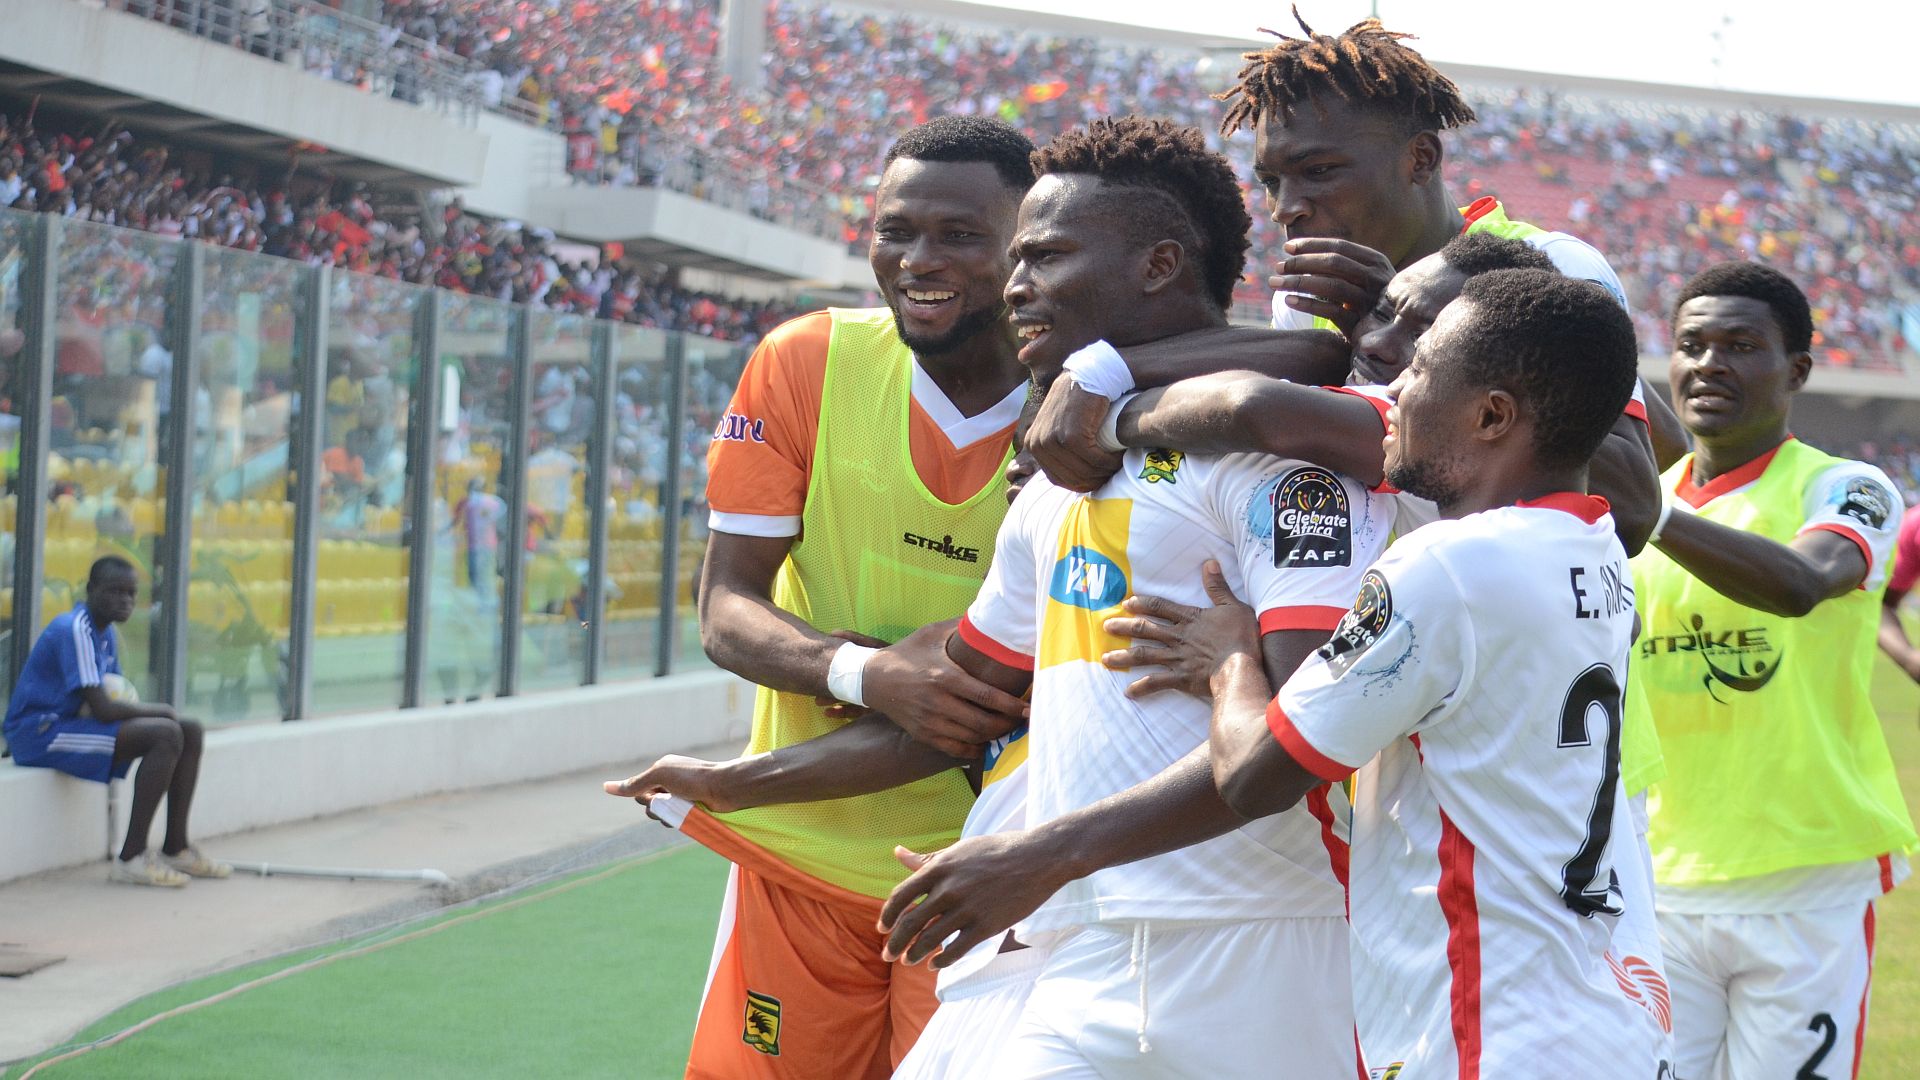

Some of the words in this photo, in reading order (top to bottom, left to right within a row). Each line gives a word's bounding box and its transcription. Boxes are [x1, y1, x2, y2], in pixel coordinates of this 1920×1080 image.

[1278, 508, 1348, 530] Celebrate
[1290, 522, 1333, 537] Africa
[903, 532, 980, 559] STRIKE
[1288, 549, 1336, 561] CAF
